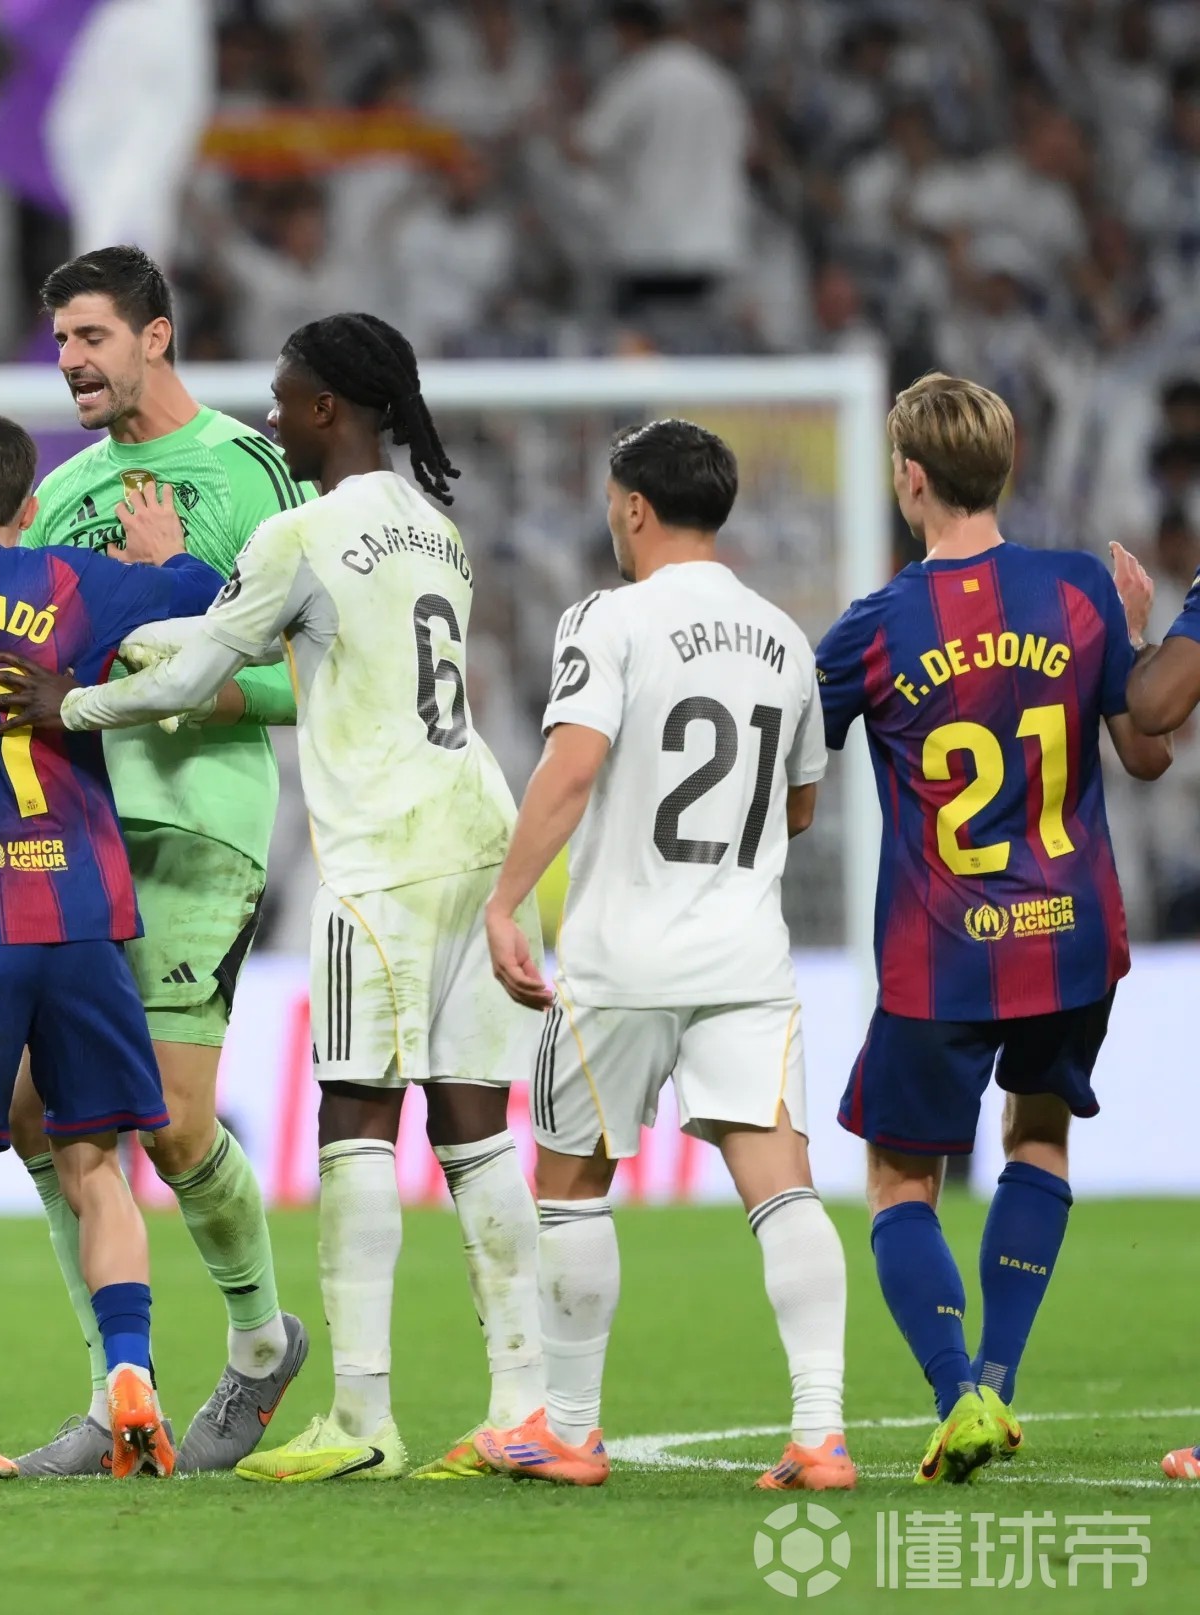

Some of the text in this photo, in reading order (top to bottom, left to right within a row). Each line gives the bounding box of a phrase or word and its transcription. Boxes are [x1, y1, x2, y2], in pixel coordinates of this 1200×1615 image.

[413, 593, 468, 750] 6
[669, 621, 786, 674] BRAHIM
[894, 631, 1071, 706] F. DE JONG
[653, 695, 783, 870] 21
[922, 704, 1075, 876] 21
[7, 839, 64, 855] UNHCR
[9, 853, 67, 868] ACNUR
[1010, 895, 1073, 918] UNHCR
[1013, 909, 1075, 932] ACNUR
